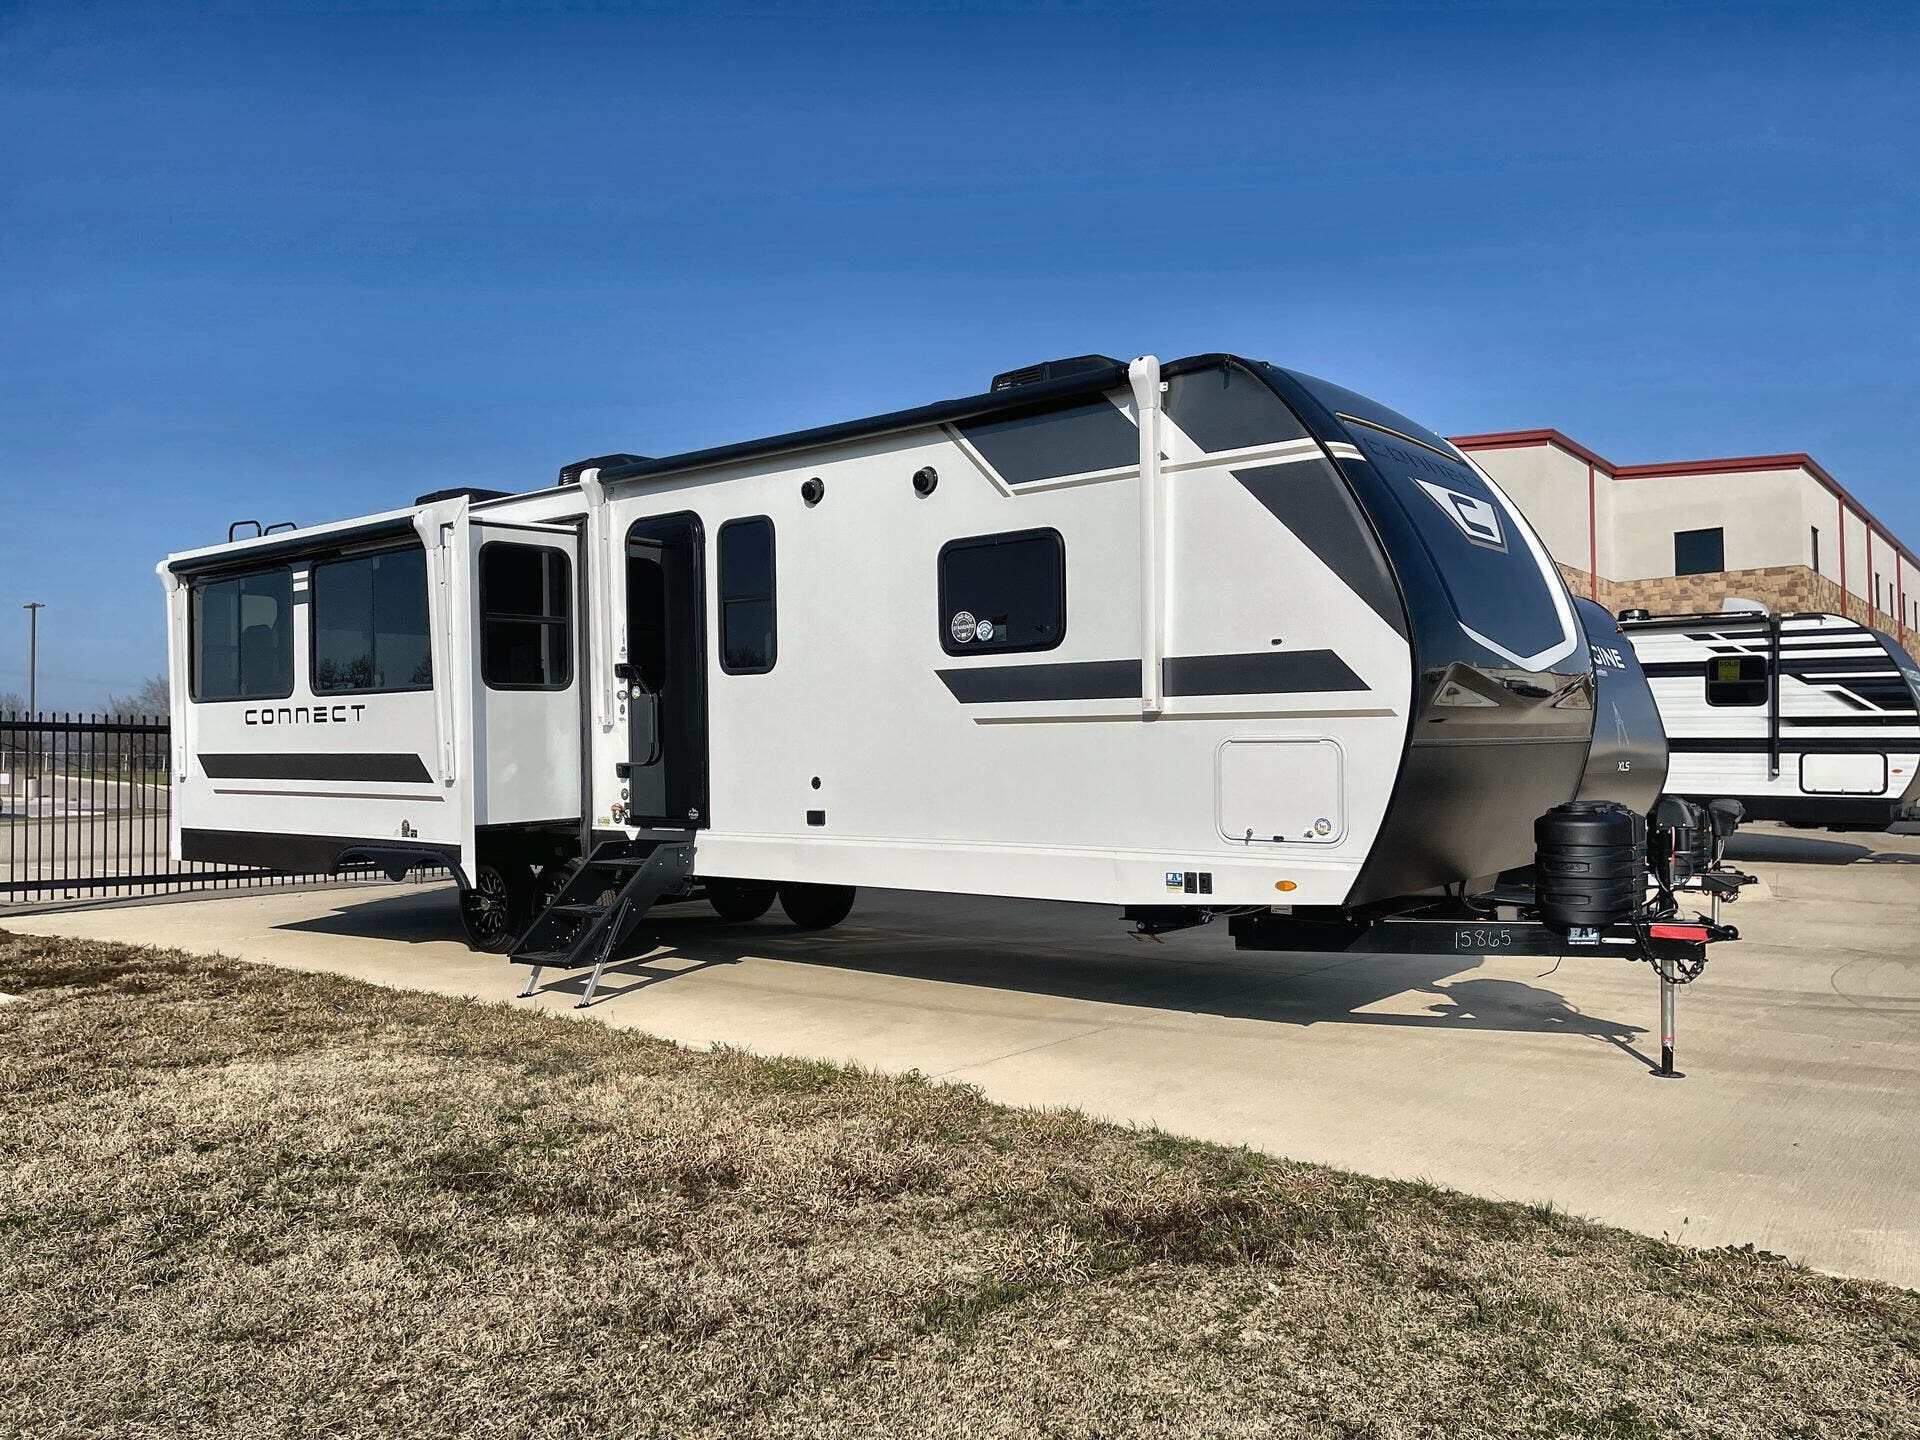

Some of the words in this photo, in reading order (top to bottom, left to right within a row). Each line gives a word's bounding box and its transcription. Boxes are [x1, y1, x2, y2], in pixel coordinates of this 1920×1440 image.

[245, 705, 366, 725] CONNECT
[1617, 761, 1631, 772] XLS
[1455, 930, 1512, 949] 15865
